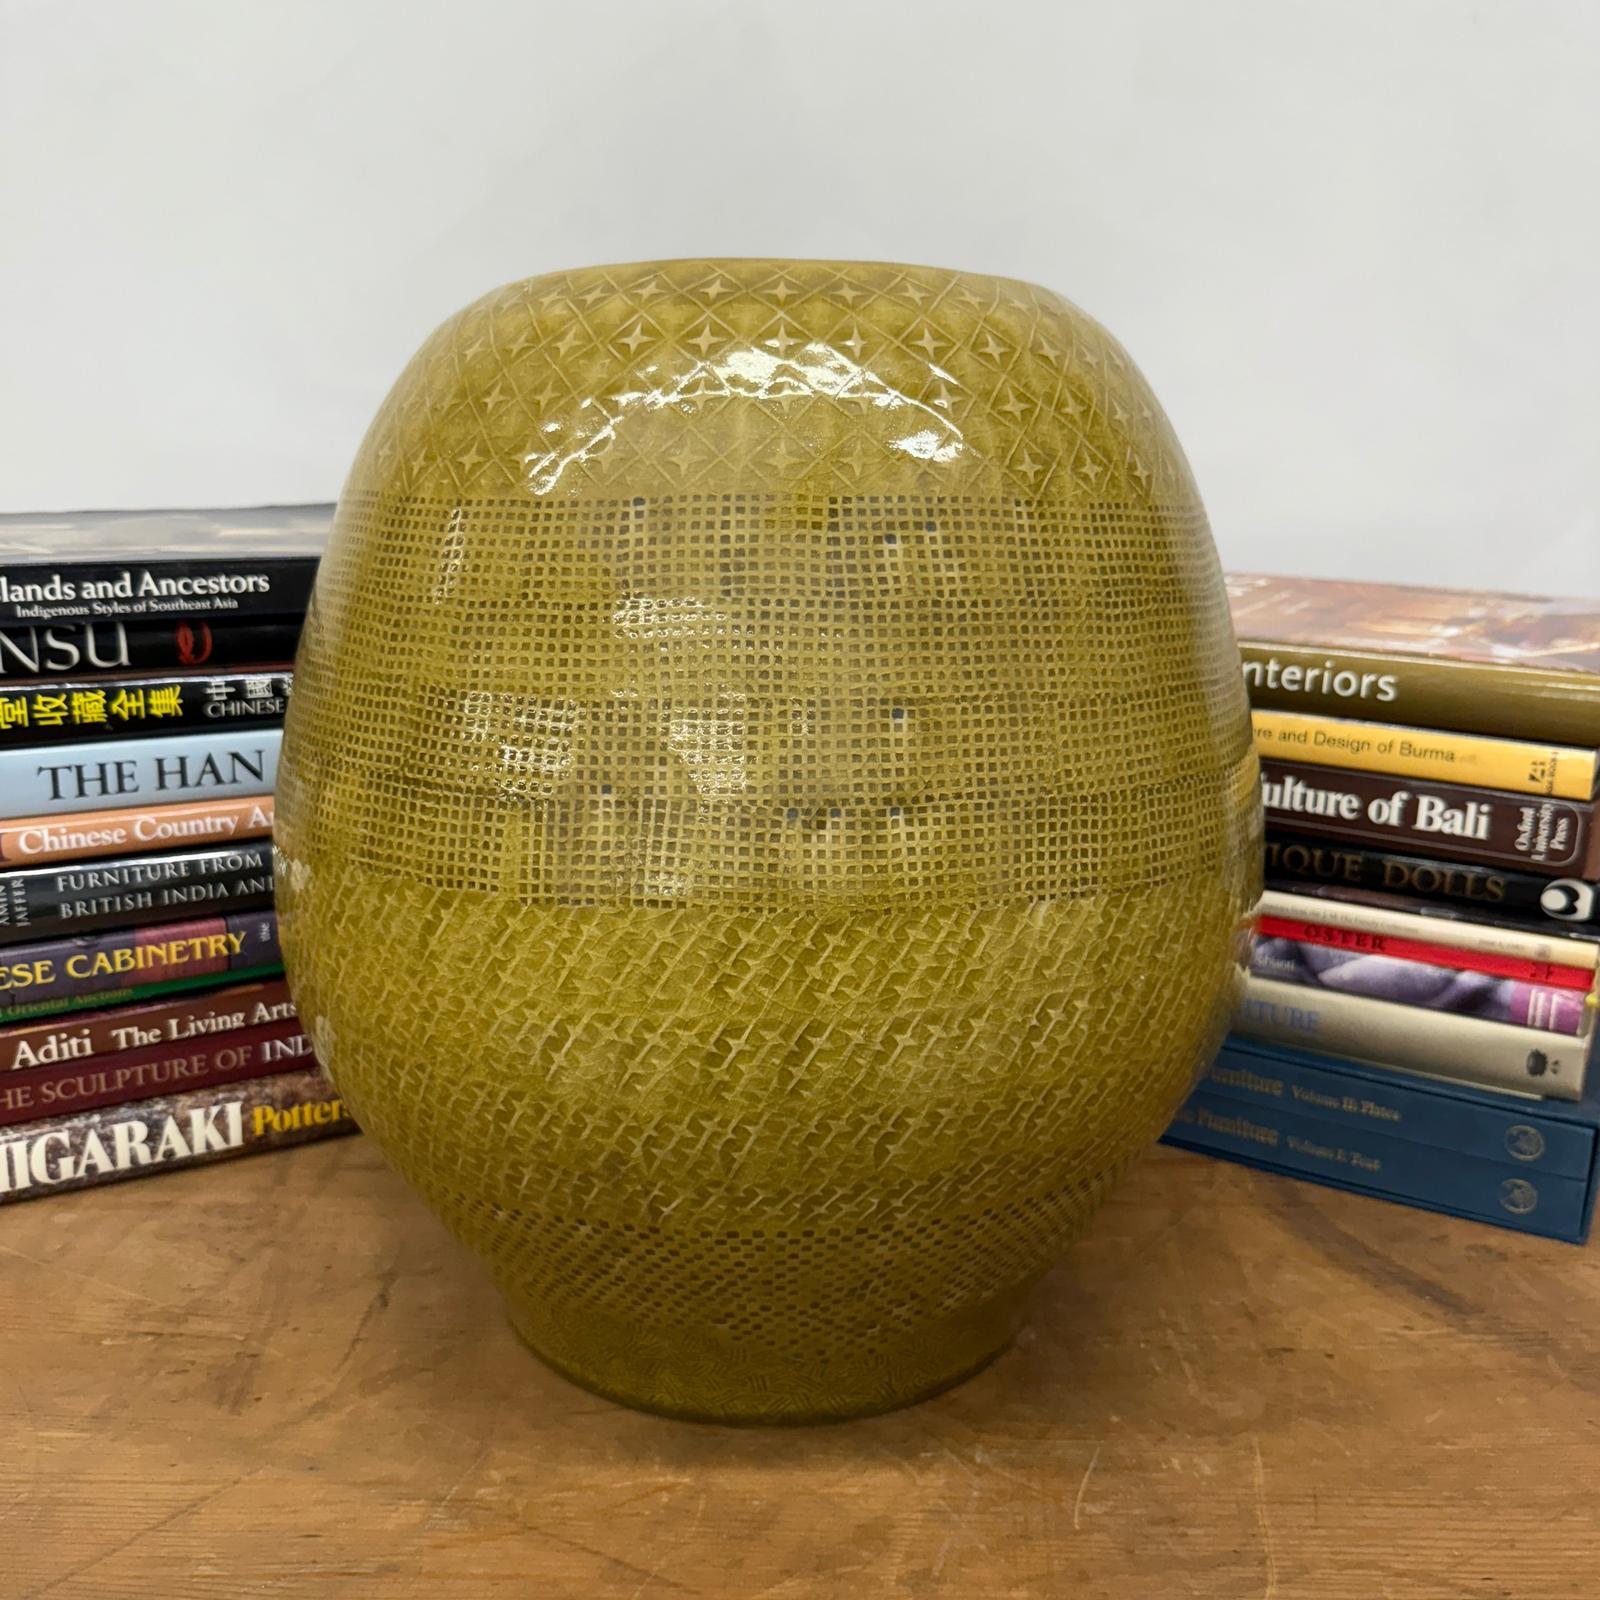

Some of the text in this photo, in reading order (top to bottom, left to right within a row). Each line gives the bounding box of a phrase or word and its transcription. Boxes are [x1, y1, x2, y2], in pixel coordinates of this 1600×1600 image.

[81, 571, 134, 599] and
[138, 569, 270, 597] Ancestors
[16, 596, 239, 620] Indigenous Styles of Southeast Asia
[205, 697, 285, 718] CHINESE
[1278, 730, 1308, 744] and
[1314, 730, 1371, 754] Design
[1377, 740, 1395, 754] of
[1400, 739, 1456, 764] Burma
[37, 749, 265, 801] THE HAN
[1260, 772, 1493, 841] ulture of Bali
[18, 826, 128, 855] Chinese
[134, 815, 240, 843] Country
[1514, 806, 1536, 852] Oxford
[1549, 816, 1570, 851] Press
[56, 852, 264, 893] FURNITURE FROM
[1382, 859, 1506, 902] DOLLS
[60, 891, 153, 919] BRITISH
[161, 882, 230, 905] INDIA
[65, 930, 247, 979] CABINETRY
[11, 1027, 95, 1071] Aditi
[110, 1024, 162, 1051] The
[169, 1011, 246, 1041] Living
[41, 1053, 209, 1104] SCULPTURE
[215, 1045, 252, 1071] OF
